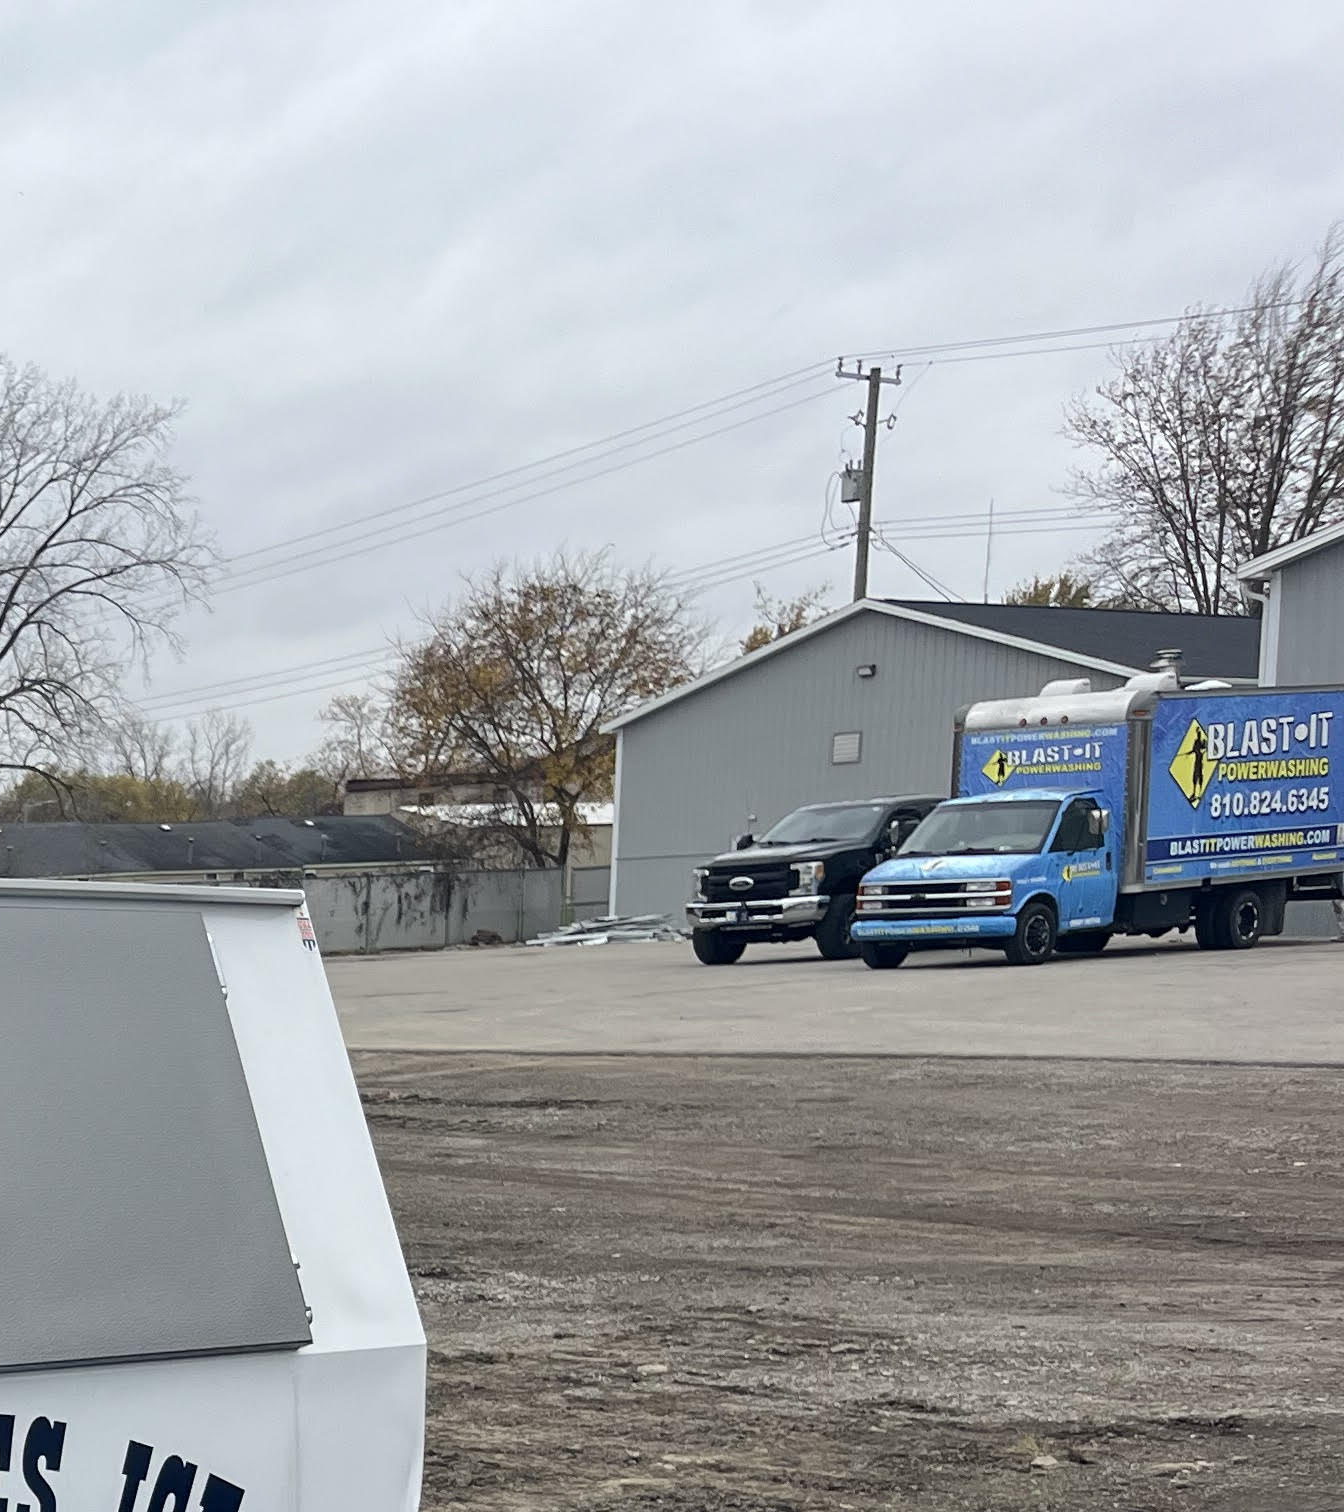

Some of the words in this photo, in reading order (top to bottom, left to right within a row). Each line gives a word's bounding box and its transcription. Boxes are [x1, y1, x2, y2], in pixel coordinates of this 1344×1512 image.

[1016, 761, 1102, 775] POWERWASHING
[1217, 758, 1329, 781] POWERWASHING
[1210, 787, 1329, 818] 810.824.6345
[1170, 830, 1331, 856] BLASTITPOWERWASHING.COM
